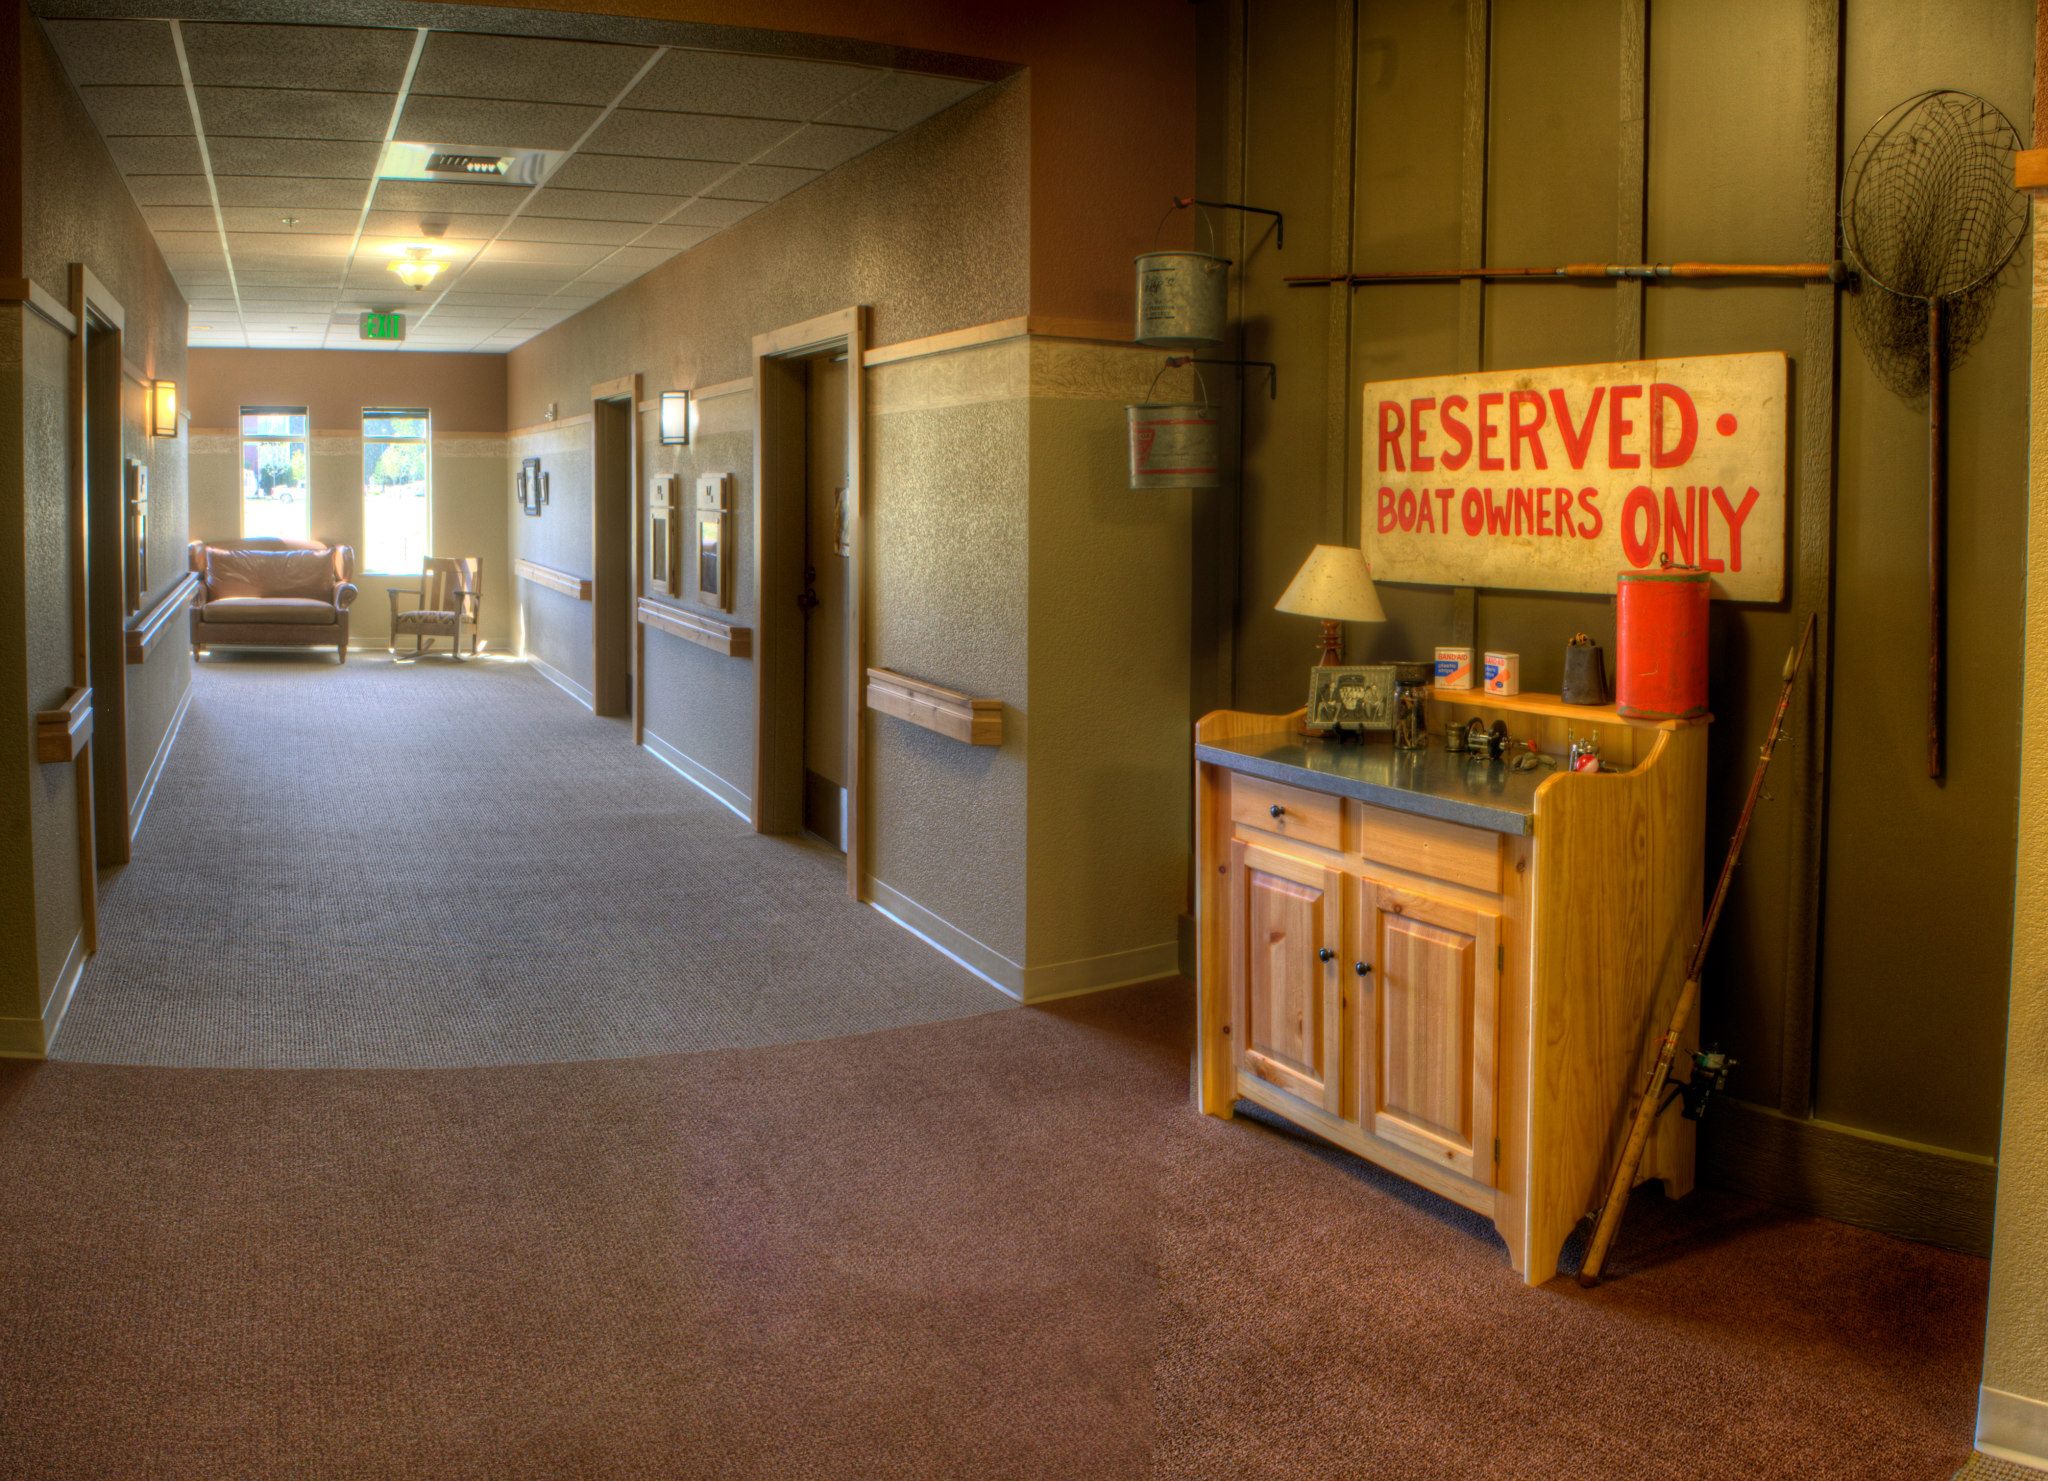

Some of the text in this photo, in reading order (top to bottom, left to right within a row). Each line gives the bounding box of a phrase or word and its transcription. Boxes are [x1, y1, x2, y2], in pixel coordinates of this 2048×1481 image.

[367, 313, 400, 339] EXIT
[1377, 485, 1760, 573] BOAT OWNERS ONLY
